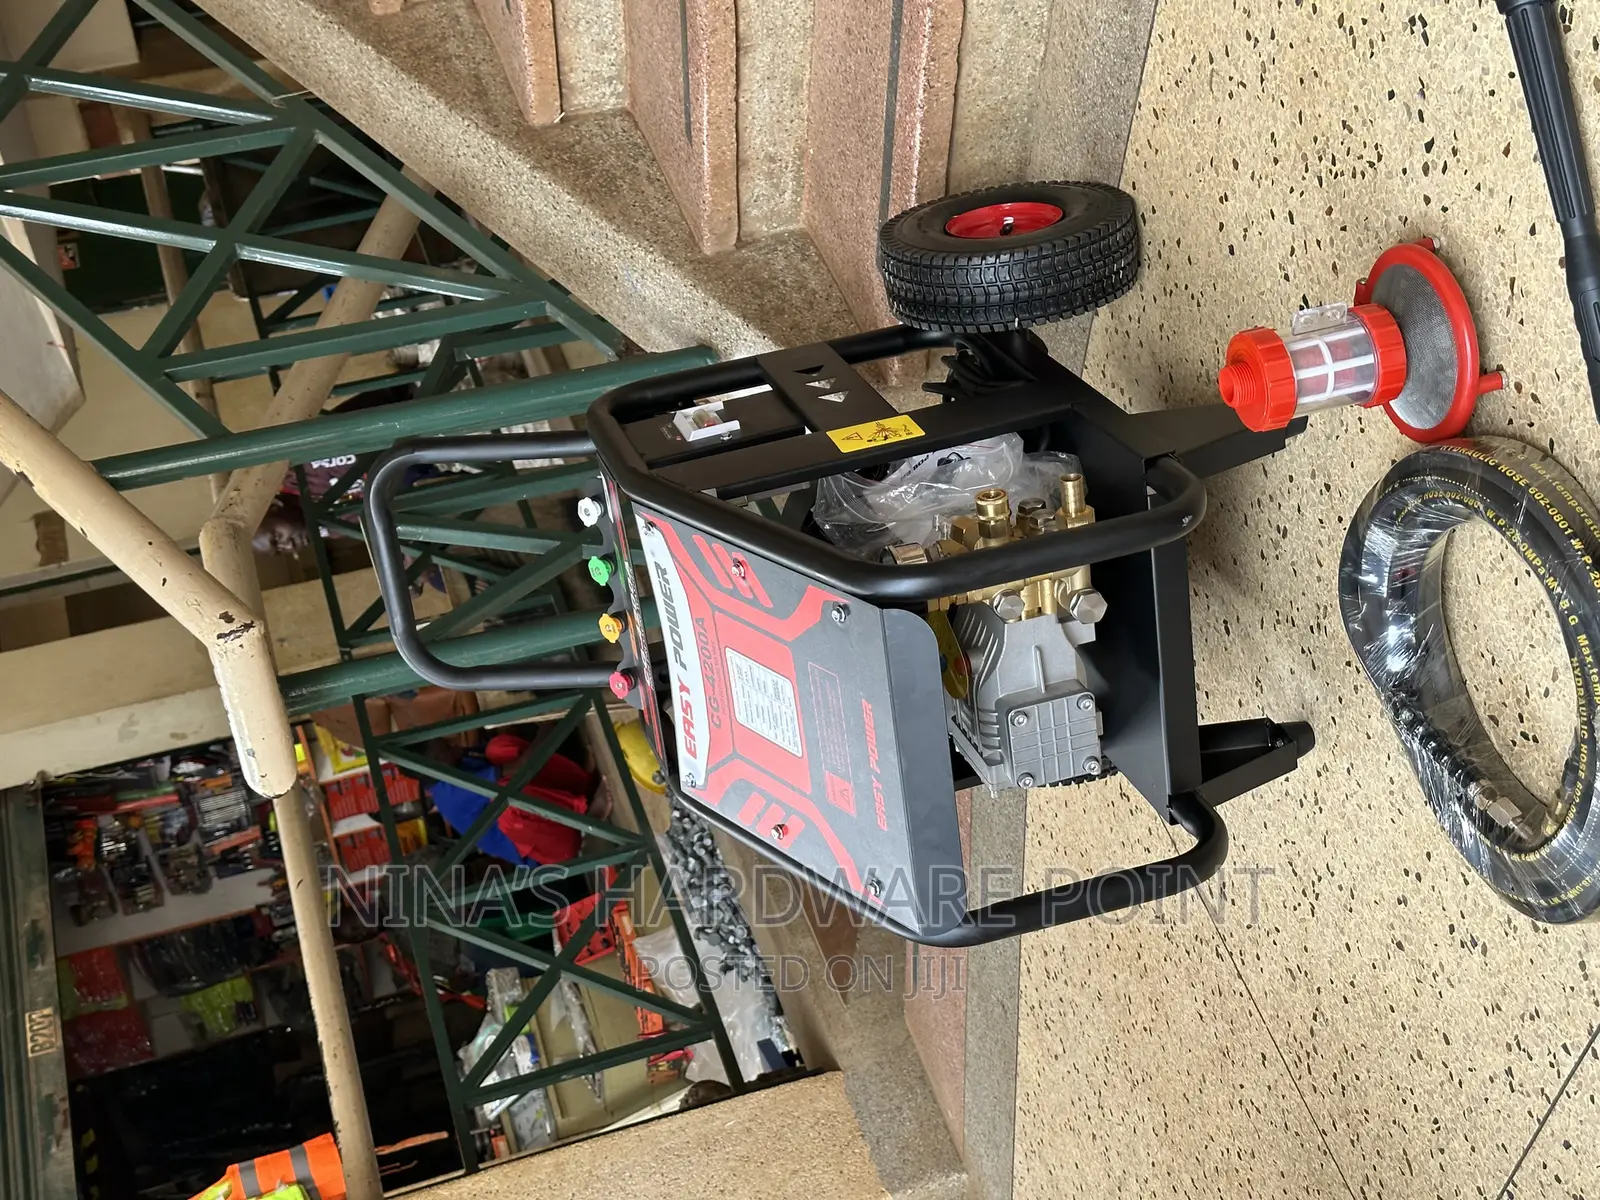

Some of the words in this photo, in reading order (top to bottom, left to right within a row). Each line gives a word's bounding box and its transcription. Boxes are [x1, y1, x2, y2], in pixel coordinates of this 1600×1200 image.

[1498, 463, 1530, 487] HOSE
[1530, 462, 1600, 541] Max.temperatu
[654, 561, 687, 671] POWER
[695, 617, 721, 729] CG-4200A
[1570, 656, 1588, 739] HYDRAULIC
[677, 673, 698, 759] EASY
[861, 698, 880, 774] POWER
[1578, 743, 1588, 779] HOSE
[871, 775, 888, 831] EASY
[29, 1013, 55, 1054] B207
